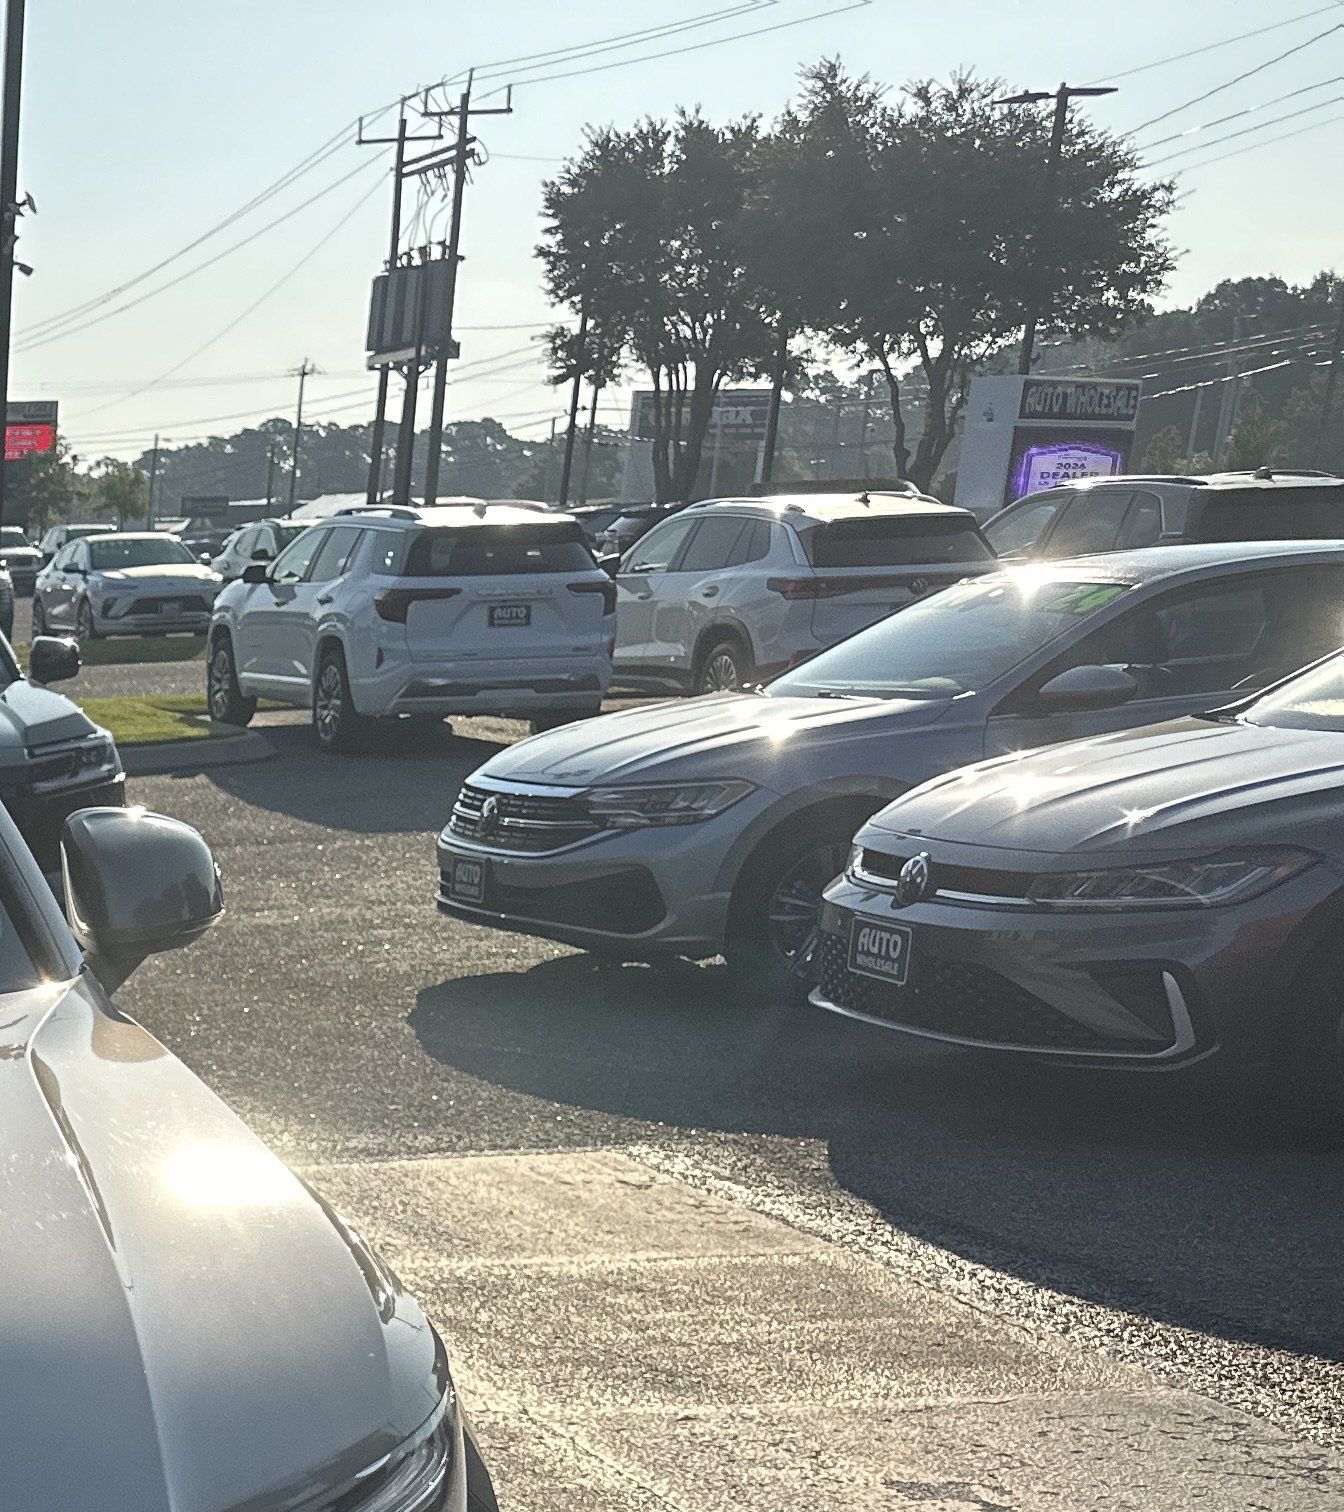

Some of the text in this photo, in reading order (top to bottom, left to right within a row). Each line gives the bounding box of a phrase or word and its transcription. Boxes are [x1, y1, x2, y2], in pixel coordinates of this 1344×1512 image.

[1025, 384, 1064, 413] AUTO
[493, 607, 528, 619] AUTO
[857, 927, 902, 959] AUTO
[856, 952, 899, 975] WHOLESALE
